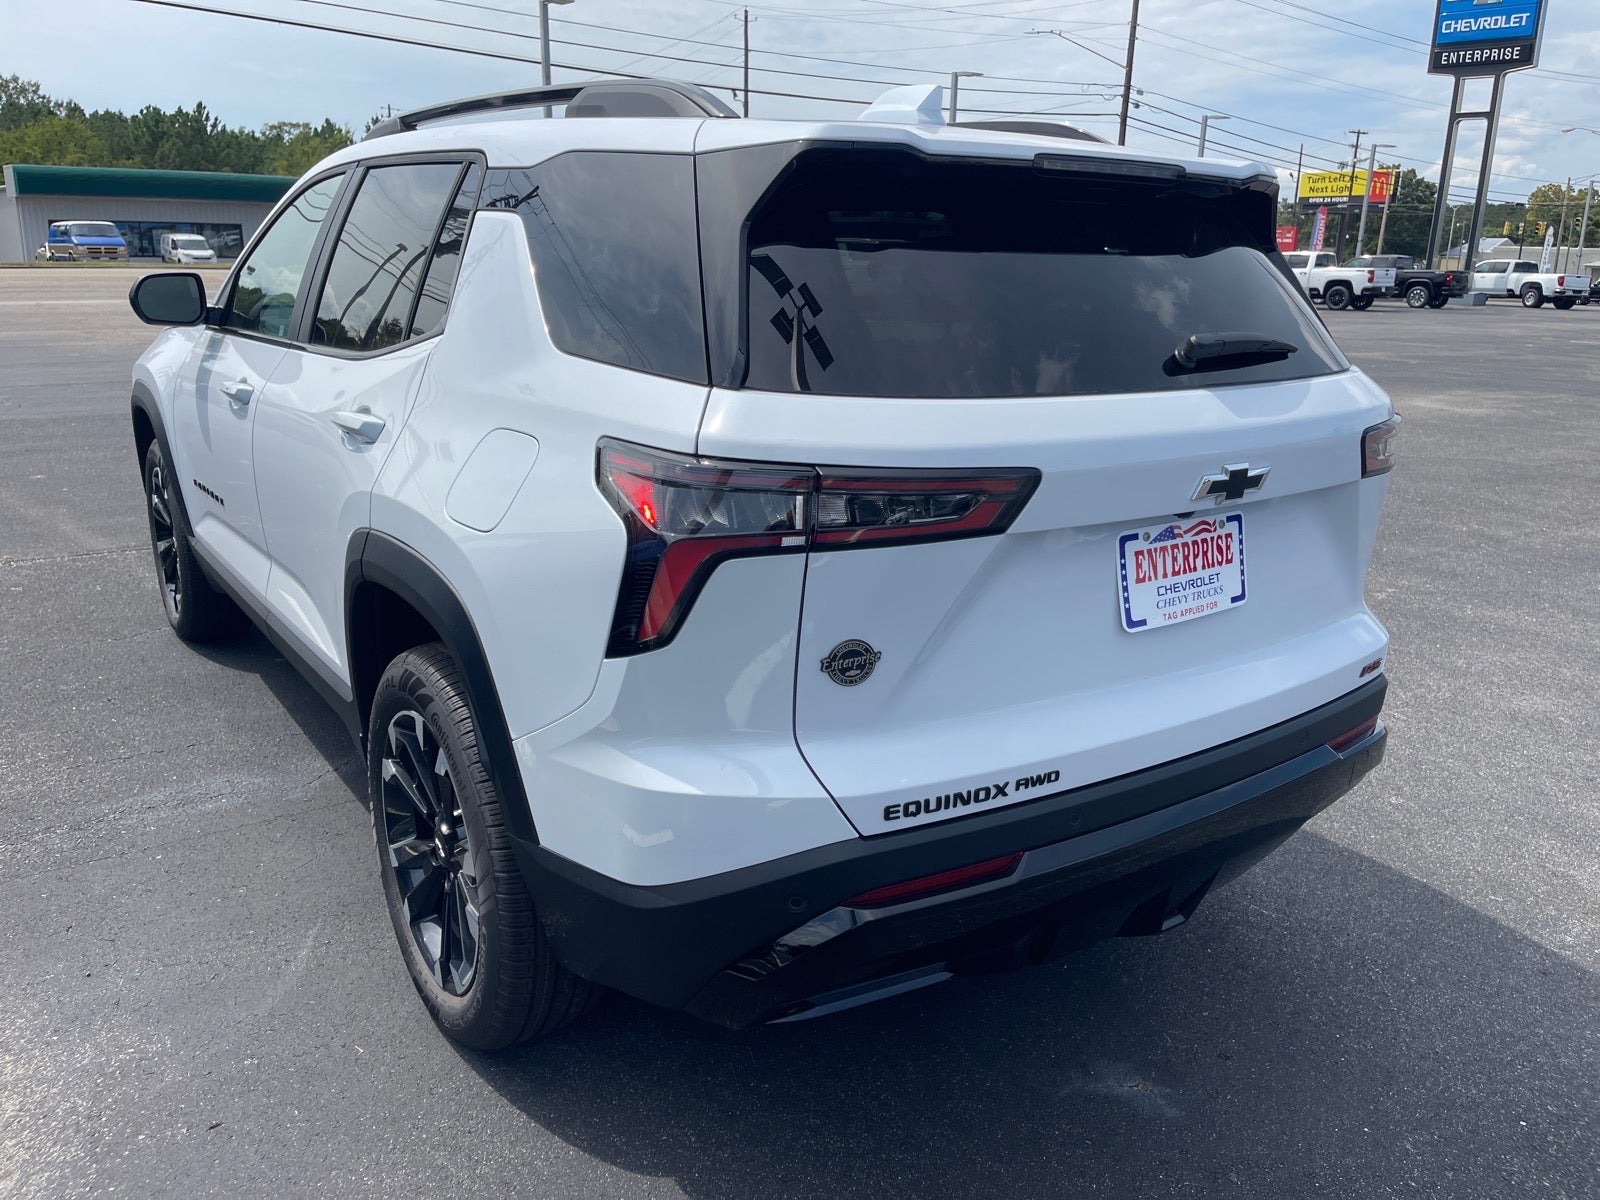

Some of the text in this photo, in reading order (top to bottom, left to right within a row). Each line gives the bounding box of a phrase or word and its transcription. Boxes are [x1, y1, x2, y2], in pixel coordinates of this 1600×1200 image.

[1441, 13, 1530, 33] CHEVROLET
[1441, 47, 1521, 65] ENTERPRISE
[1307, 176, 1326, 184] Turn
[1328, 175, 1346, 183] Left
[1308, 184, 1351, 194] Next Ligh
[1134, 532, 1234, 584] ENTERPRISE
[1157, 572, 1221, 597] CHEVROLET
[1156, 585, 1224, 610] CHEVY TRUCKS
[1162, 601, 1218, 621] TAG APPLIED FOR
[836, 643, 866, 656] CHEVROLET
[822, 652, 881, 672] Enterprise
[883, 770, 1061, 822] EQUINOX AWD
